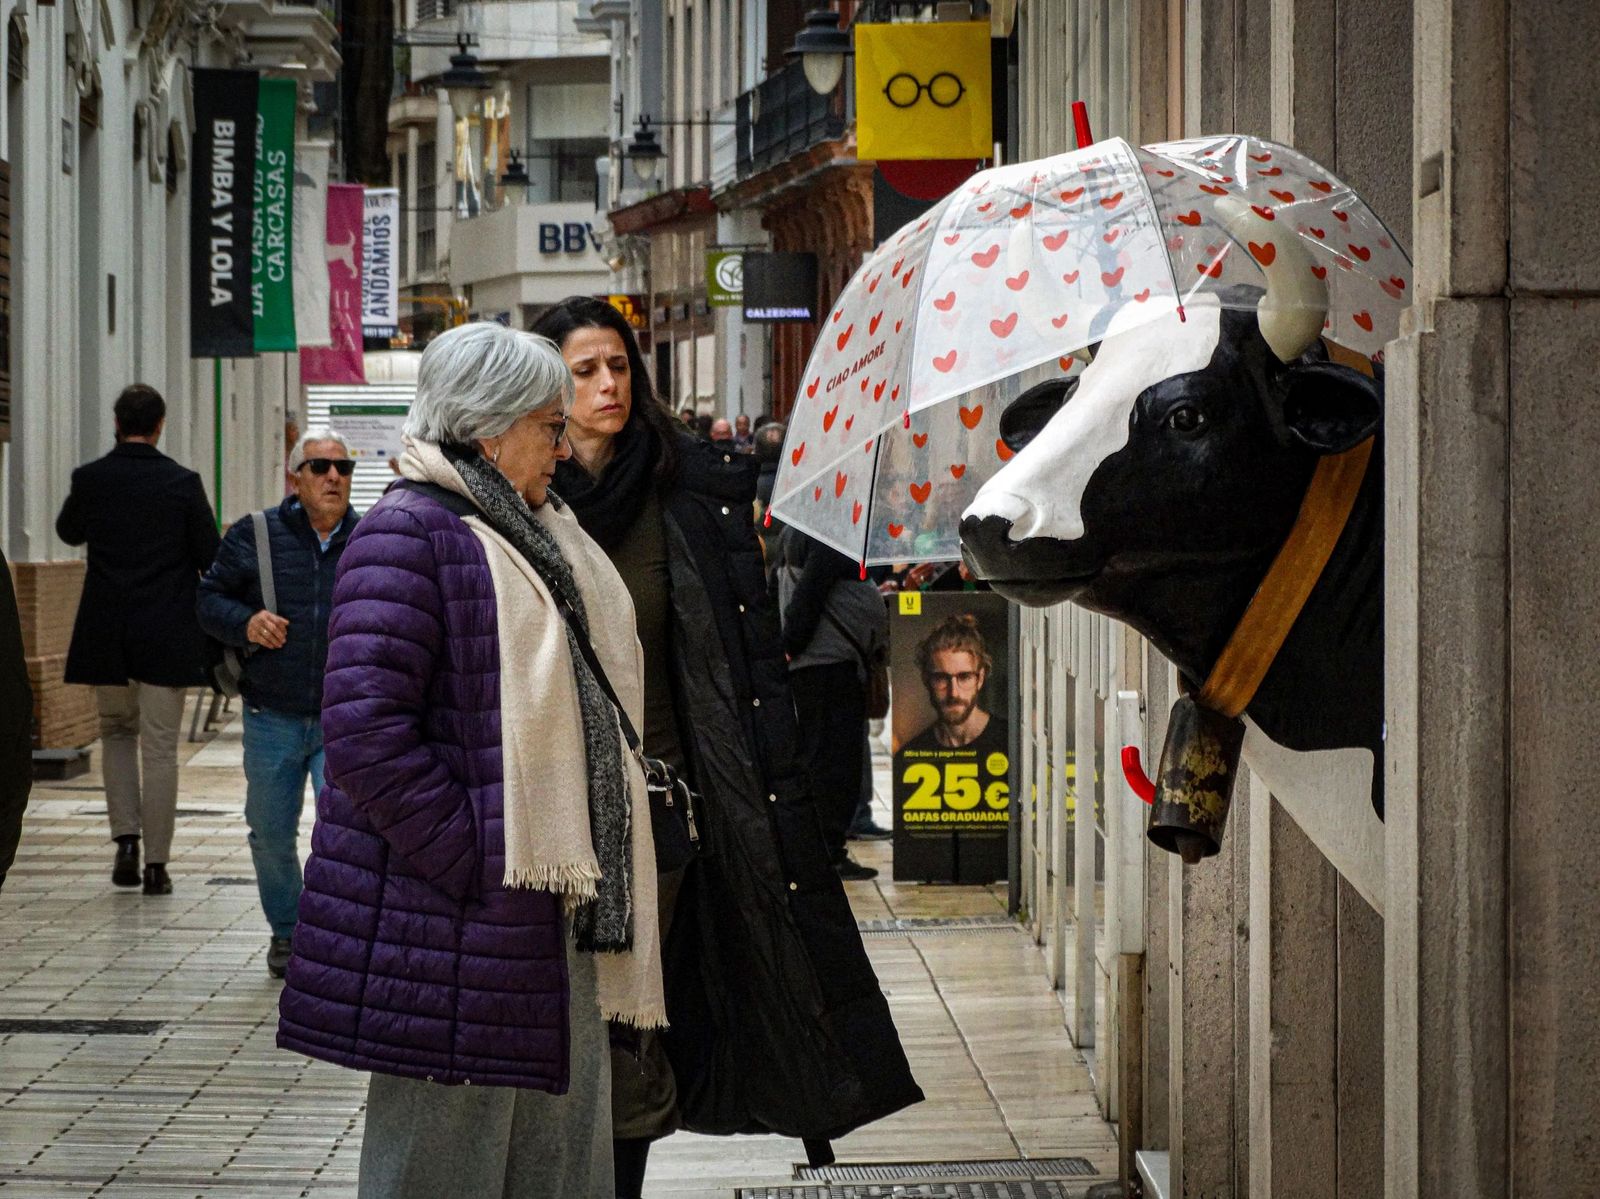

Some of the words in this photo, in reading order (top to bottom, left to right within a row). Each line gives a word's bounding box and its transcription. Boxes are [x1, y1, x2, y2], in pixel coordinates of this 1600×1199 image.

[211, 120, 236, 209] BIMBA
[211, 212, 233, 233] Y
[267, 150, 286, 282] CARCASAS
[210, 238, 233, 307] LOLA
[370, 215, 391, 317] ANDAMIOS
[745, 307, 811, 318] CALZEDONIA
[826, 367, 850, 393] CIAO
[851, 339, 887, 377] AMORE
[903, 812, 940, 822] GAFAS
[940, 812, 1009, 822] GRADUADAS
